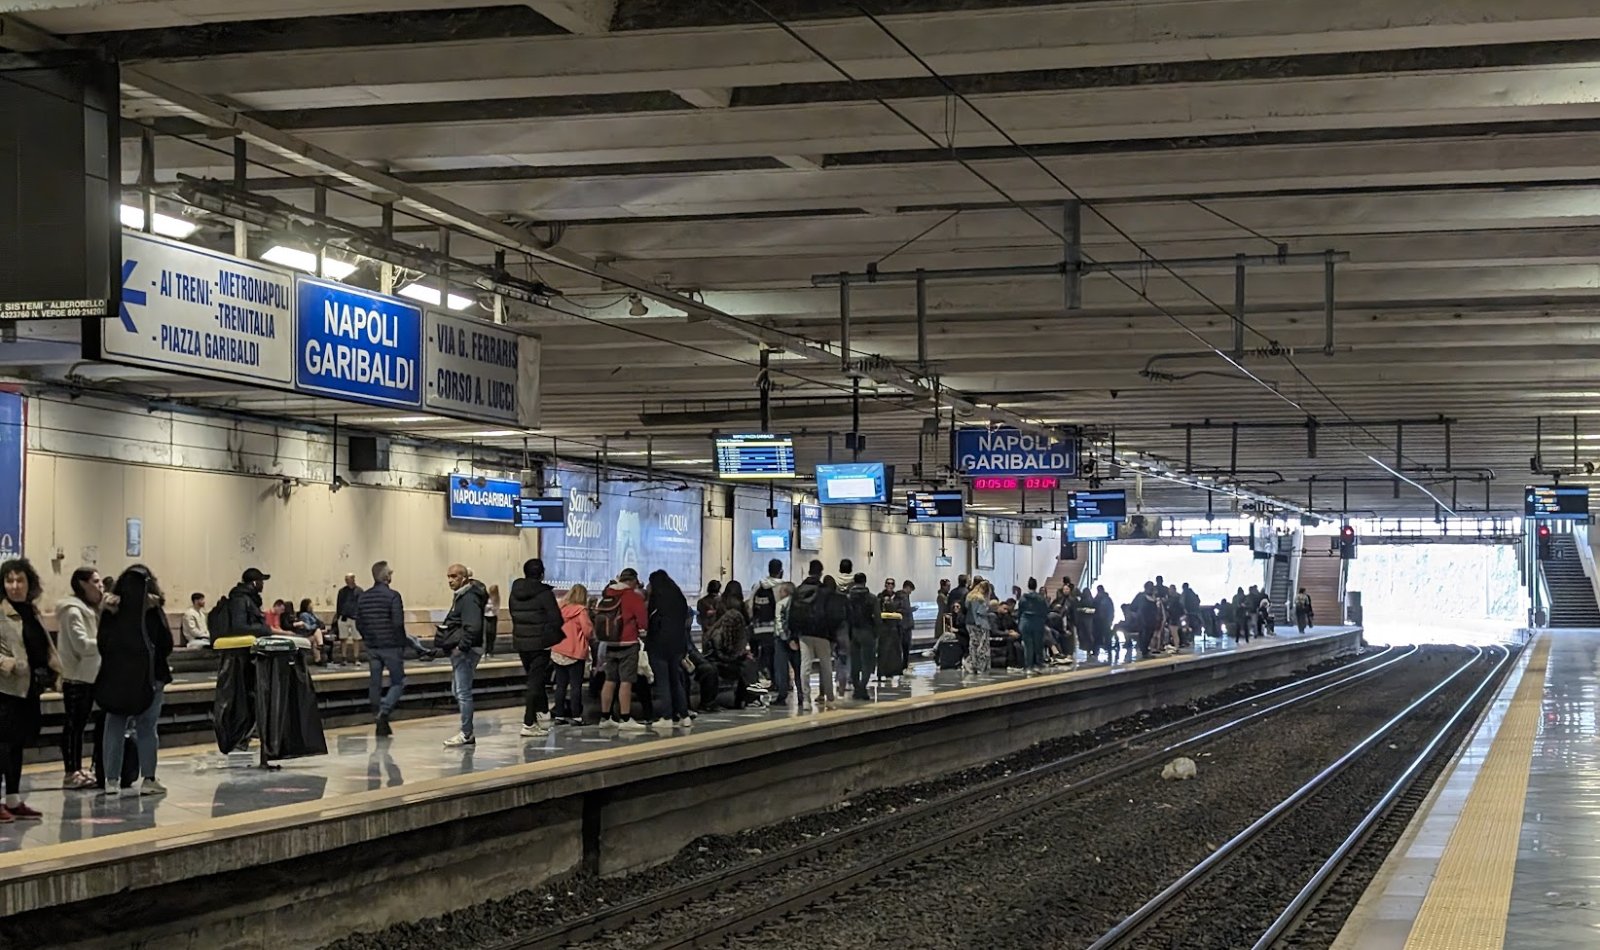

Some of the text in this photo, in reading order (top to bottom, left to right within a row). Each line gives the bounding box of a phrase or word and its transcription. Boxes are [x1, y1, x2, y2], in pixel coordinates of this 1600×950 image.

[5, 302, 43, 310] SISTEMI
[50, 300, 105, 309] ALBEROBELLO
[160, 269, 172, 297] AI
[175, 273, 213, 306] TRENI:
[324, 300, 398, 348] NAPOLI
[161, 324, 201, 357] PIAZZA
[205, 332, 260, 367] GARIBALDI
[305, 339, 414, 391] GARIBALDI
[437, 323, 455, 355] VIA
[458, 328, 469, 358] G.
[472, 331, 518, 369] FERRARIS
[437, 368, 471, 403] CORSO
[475, 376, 485, 405] A.
[488, 379, 515, 412] LUCCI
[962, 454, 1070, 470] GARIBALDI
[978, 435, 1052, 451] NAPOLI
[566, 512, 602, 544] Stefano
